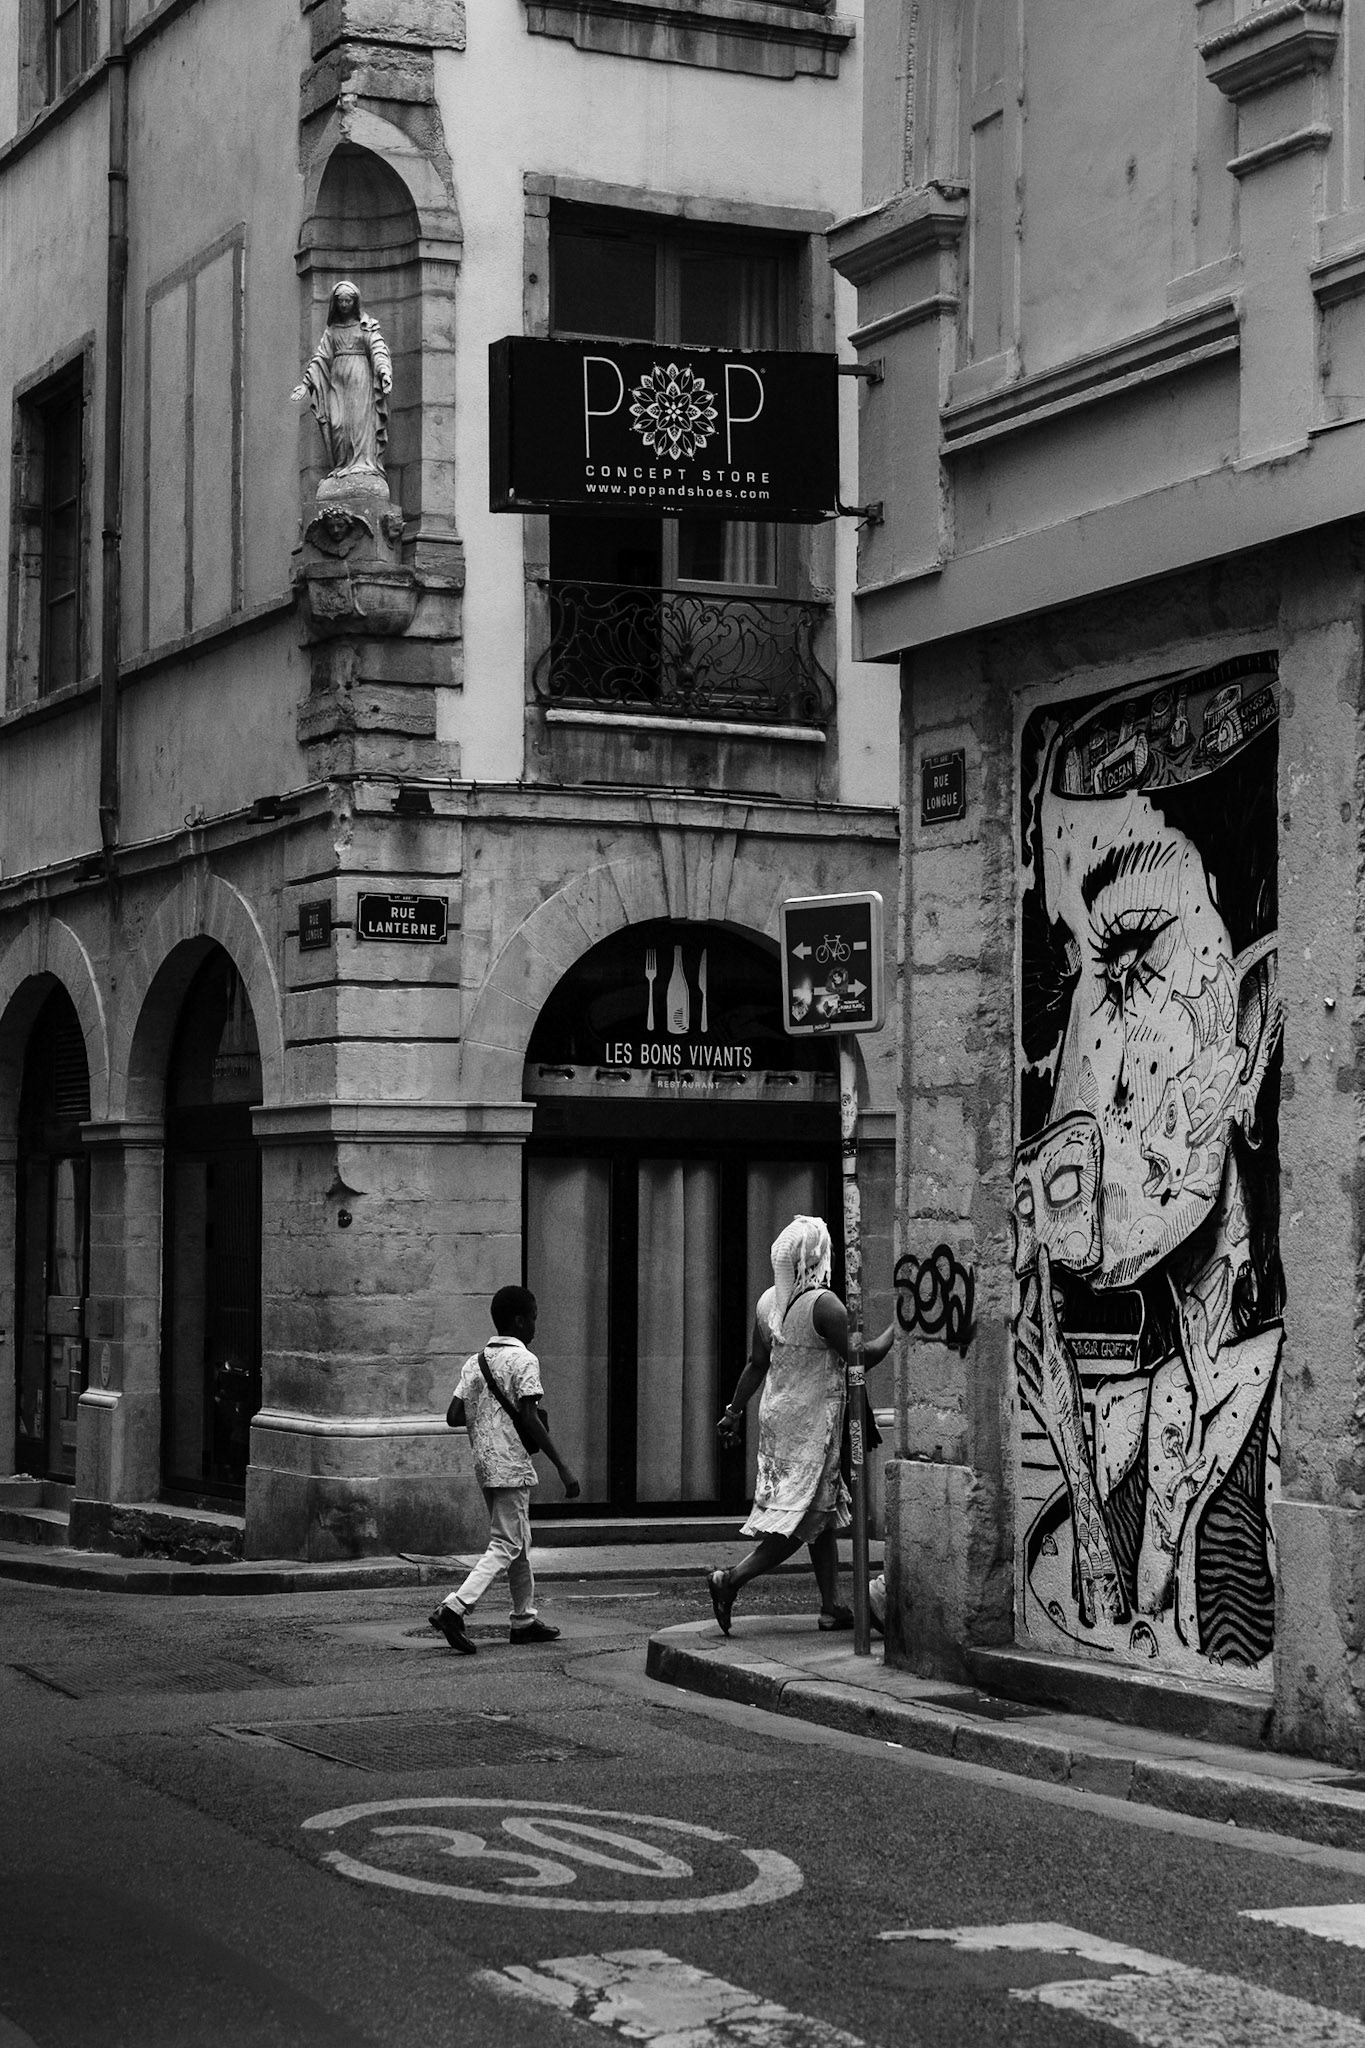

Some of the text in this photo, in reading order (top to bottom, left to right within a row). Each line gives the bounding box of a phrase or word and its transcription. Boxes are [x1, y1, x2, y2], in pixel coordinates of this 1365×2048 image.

[585, 464, 770, 484] CONCEPT STORE
[585, 482, 770, 499] www.popandshoes.com
[933, 773, 949, 789] RUE
[926, 791, 958, 811] LONGUE
[390, 906, 416, 919] RUE
[368, 920, 437, 936] LANTERNE
[605, 1042, 752, 1068] LES BONS VIVANTS
[657, 1080, 720, 1089] RESTAURANT
[369, 1816, 693, 1887] 30
